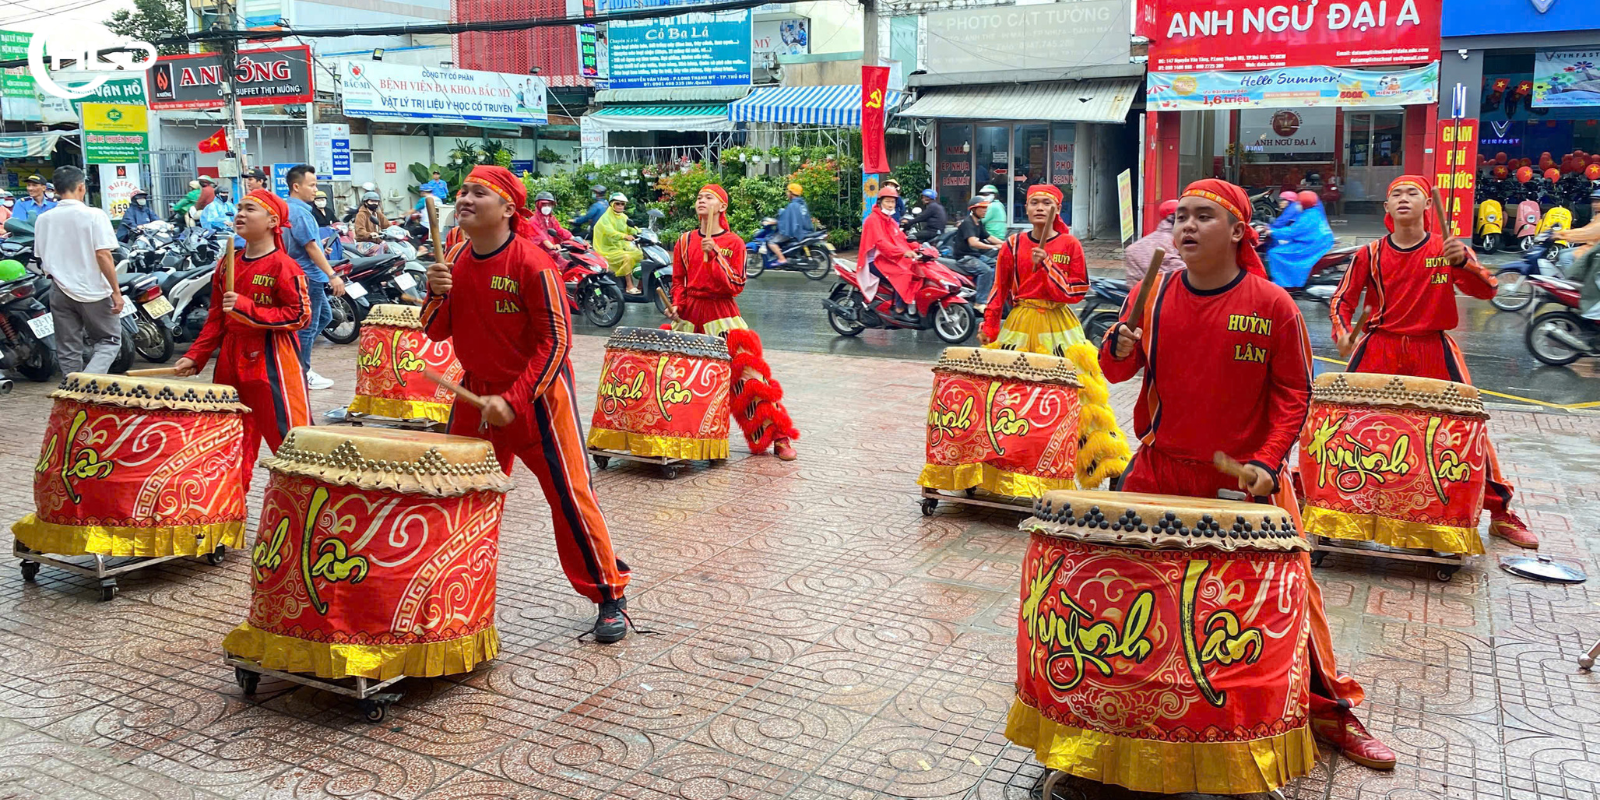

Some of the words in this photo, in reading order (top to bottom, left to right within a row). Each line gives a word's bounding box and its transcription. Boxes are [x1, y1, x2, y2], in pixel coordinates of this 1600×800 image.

[946, 14, 1002, 30] PHOTO
[1167, 9, 1233, 38] ANH
[1327, 0, 1386, 32] ĐẠI
[668, 28, 688, 39] Ba
[690, 26, 709, 38] Lá
[180, 67, 199, 86] A
[422, 70, 439, 79] CÔNG
[1240, 76, 1273, 86] Hello
[1277, 73, 1342, 85] Summer!
[124, 80, 141, 96] HỒ
[236, 87, 260, 96] BUFFET
[260, 86, 275, 96] THỊT
[380, 77, 407, 92] BỆNH
[410, 80, 433, 94] VIỆN
[435, 84, 448, 92] ĐA
[450, 84, 477, 95] KHOA
[478, 84, 496, 96] BẮC
[498, 86, 511, 98] MỸ
[381, 96, 398, 109] VẬT
[400, 96, 411, 107] LÝ
[413, 99, 426, 110] TRỊ
[427, 98, 444, 111] LIỆU
[454, 102, 470, 112] HỌC
[484, 102, 513, 113] TRUYỀN
[1203, 95, 1222, 106] 1,6
[1224, 94, 1250, 105] triệu
[1310, 136, 1316, 145] Á
[1442, 122, 1473, 142] GIẢM
[1446, 146, 1467, 166] PHÍ
[1437, 170, 1473, 189] TRƯỚC
[391, 330, 426, 387] Lân
[1234, 344, 1267, 364] LÂN
[655, 354, 692, 422] Lân
[985, 381, 1030, 456] Lân
[62, 410, 114, 504] Lân
[1308, 413, 1410, 492] Huỳnh
[1425, 416, 1471, 505] Lân
[302, 486, 369, 616] Lân
[1022, 554, 1157, 692] Huỳnh
[1180, 560, 1264, 708] Lân
